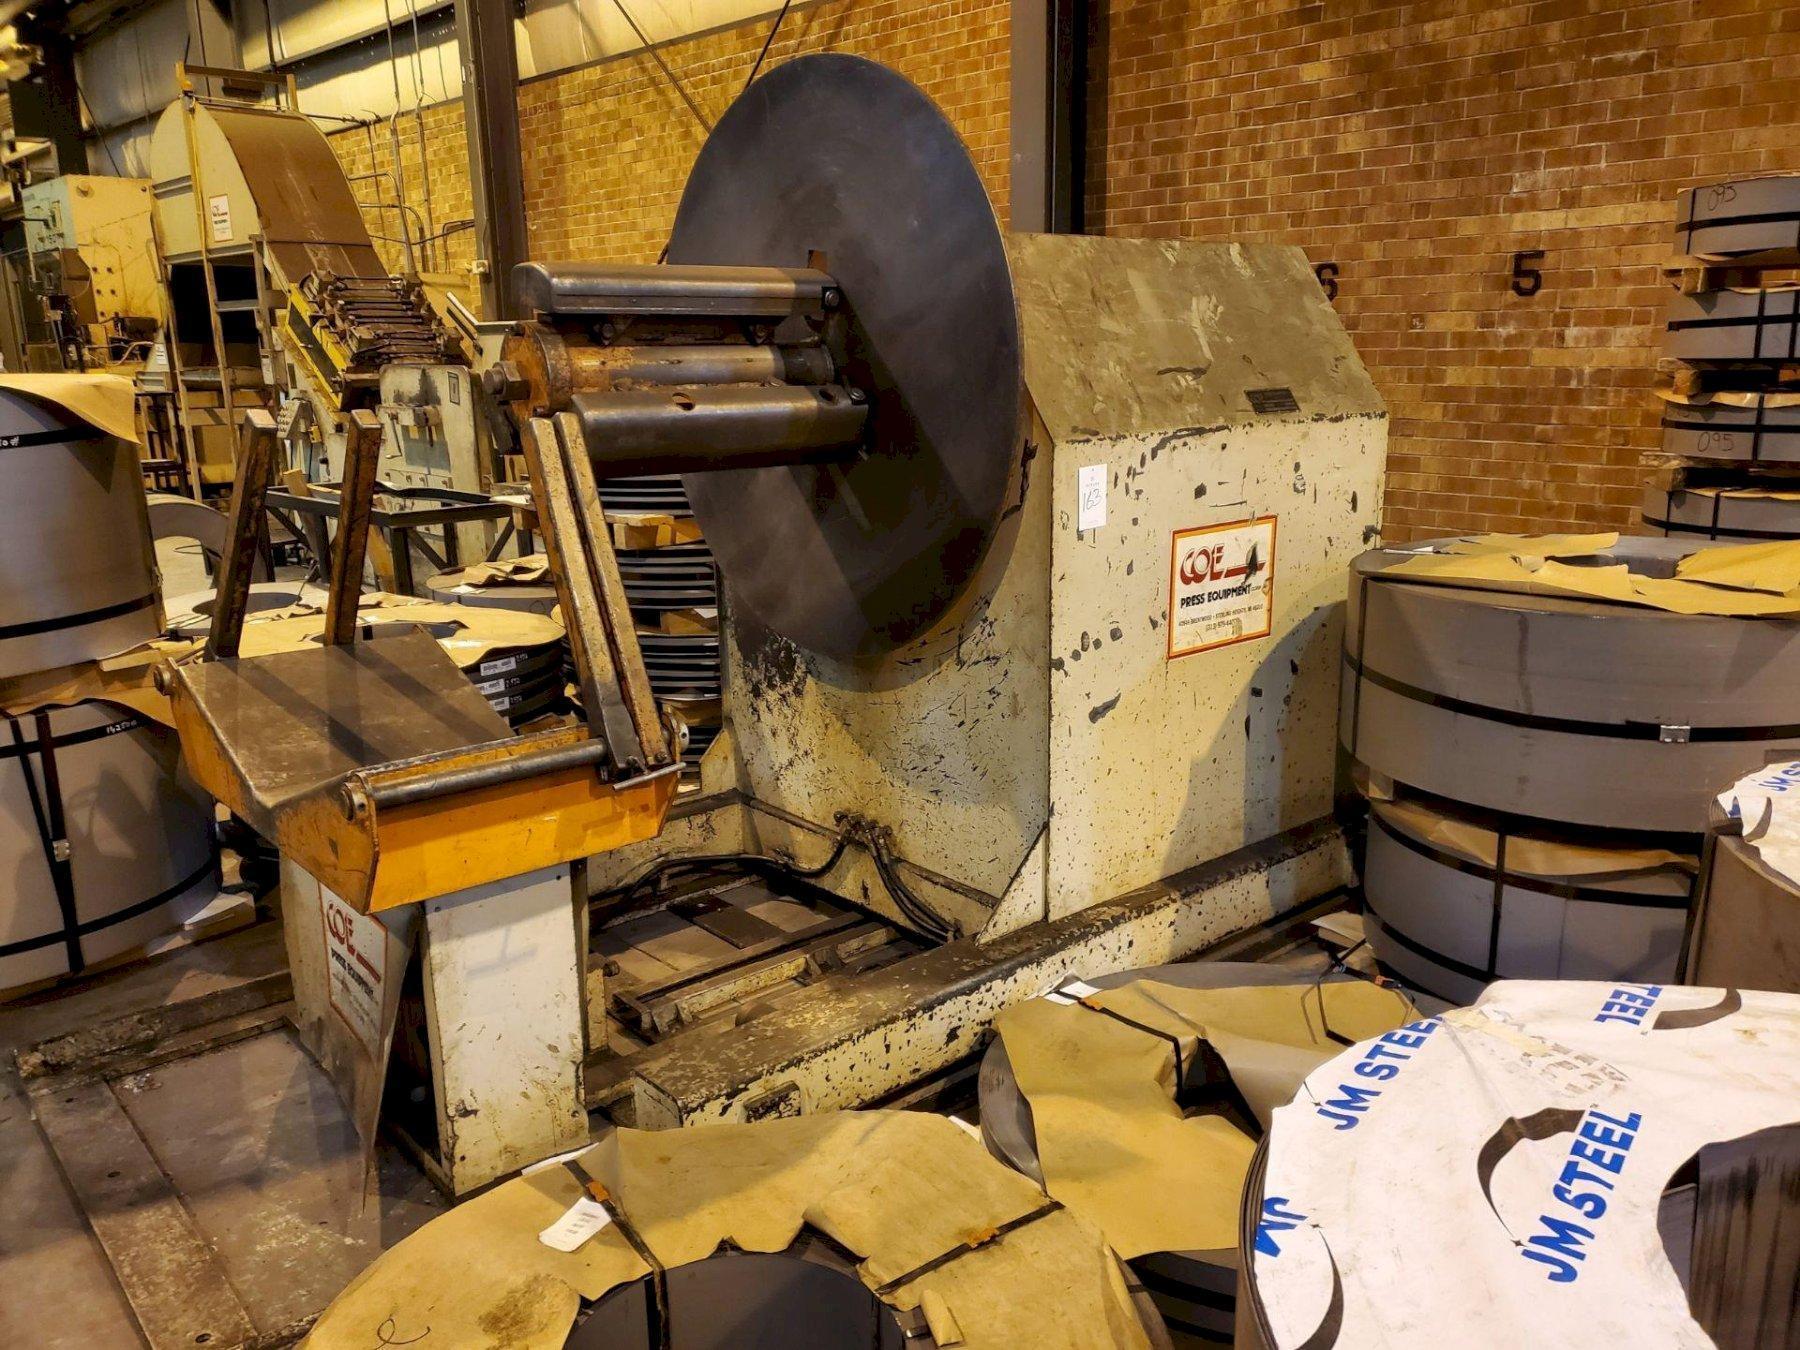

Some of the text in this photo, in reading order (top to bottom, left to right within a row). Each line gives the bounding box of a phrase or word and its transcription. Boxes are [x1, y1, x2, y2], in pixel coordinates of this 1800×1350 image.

[1315, 262, 1338, 302] 6
[1512, 250, 1545, 296] 5
[1082, 488, 1102, 512] 163
[1180, 543, 1225, 586] COE
[1180, 592, 1206, 609] PRESS
[1207, 583, 1252, 603] EQUIPMENT
[326, 900, 356, 957] COE
[1316, 1016, 1443, 1130] JM STEE
[1553, 1110, 1642, 1220] STEEL
[1521, 1204, 1595, 1283] JM
